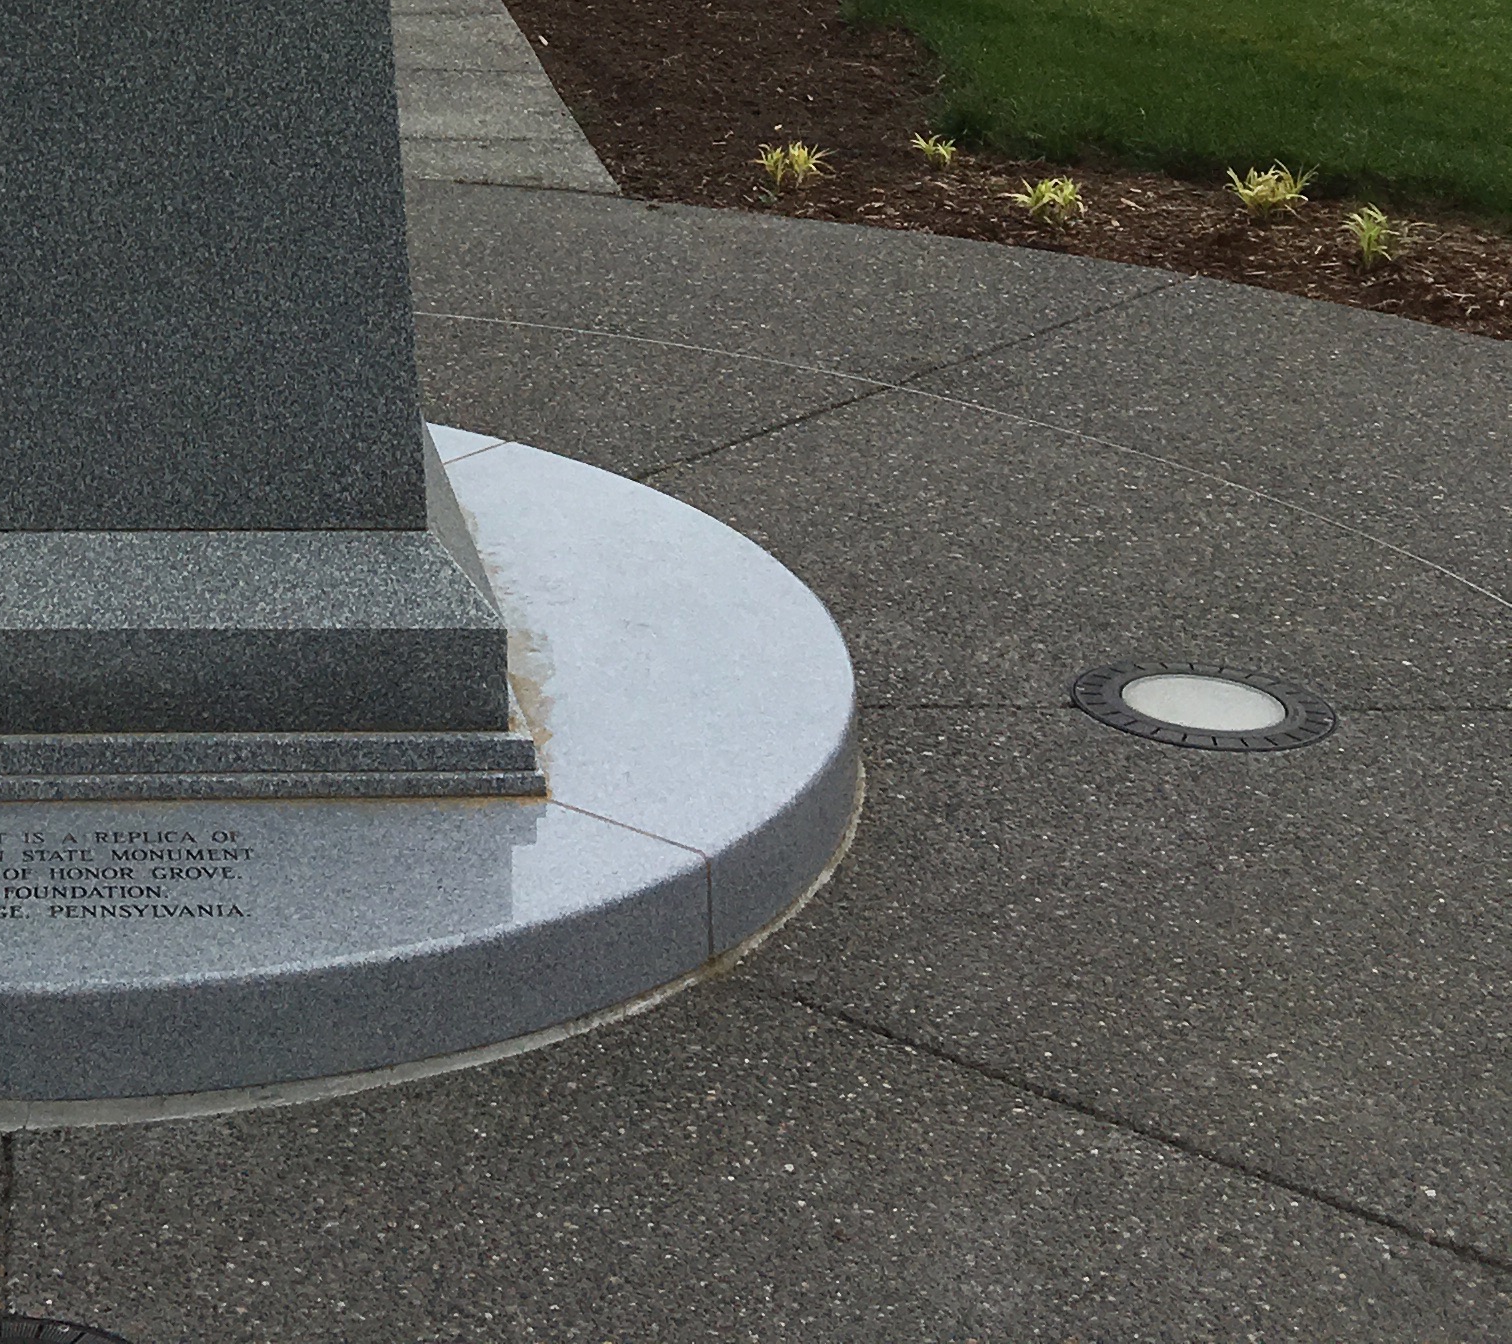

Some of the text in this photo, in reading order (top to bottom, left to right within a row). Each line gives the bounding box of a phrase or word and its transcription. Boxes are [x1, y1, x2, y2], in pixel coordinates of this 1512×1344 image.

[24, 832, 44, 843] IS
[62, 832, 78, 843] A
[95, 831, 198, 844] REPLICA
[211, 831, 240, 843] OF
[23, 850, 93, 862] STATE
[112, 848, 254, 862] MONUMENT
[3, 868, 31, 880] OF
[50, 867, 134, 881] HONOR
